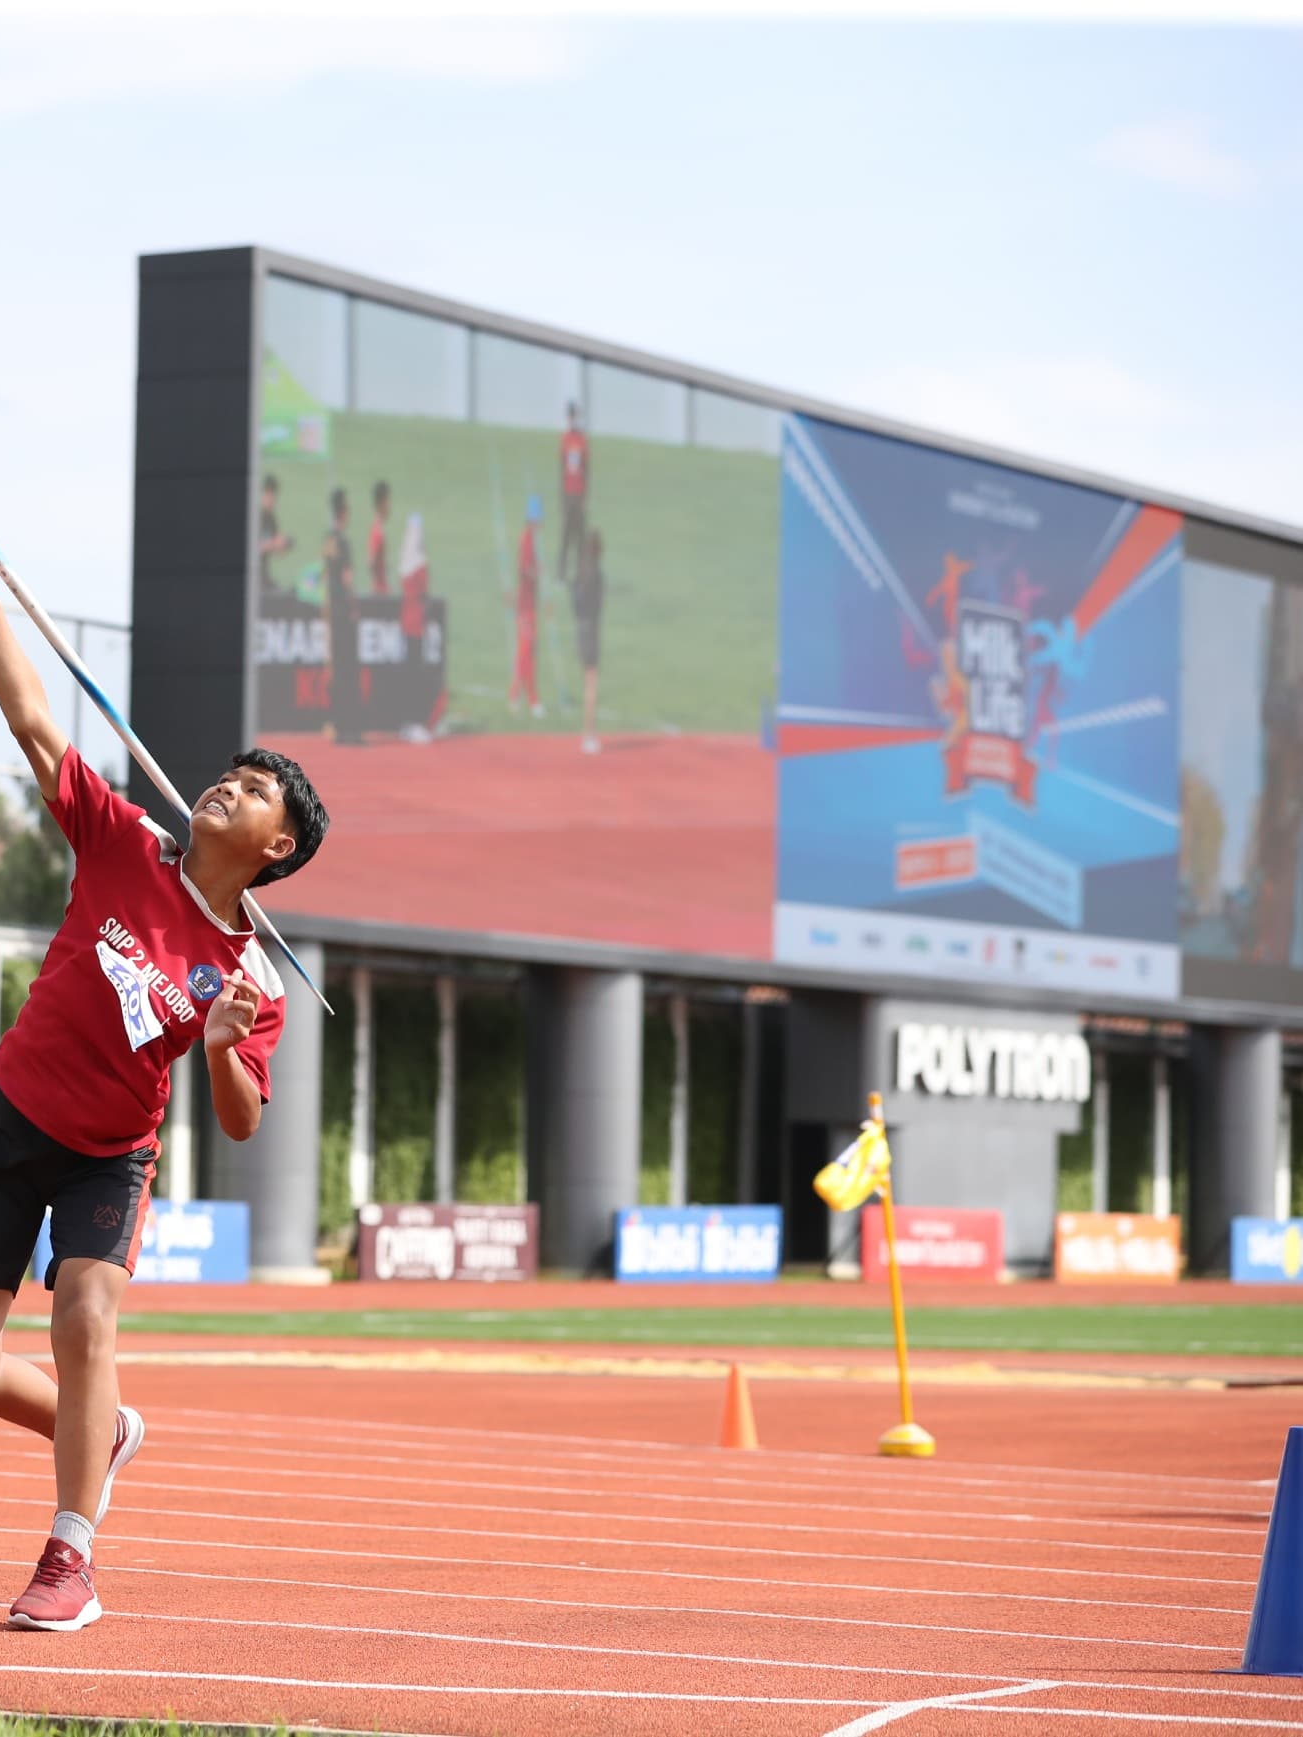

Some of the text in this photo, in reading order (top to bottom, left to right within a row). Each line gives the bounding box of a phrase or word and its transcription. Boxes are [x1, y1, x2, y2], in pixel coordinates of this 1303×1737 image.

[99, 917, 135, 950] SMP
[128, 949, 146, 962] 2
[140, 962, 196, 1023] MEJOBO
[897, 1022, 1092, 1103] POLYTRON
